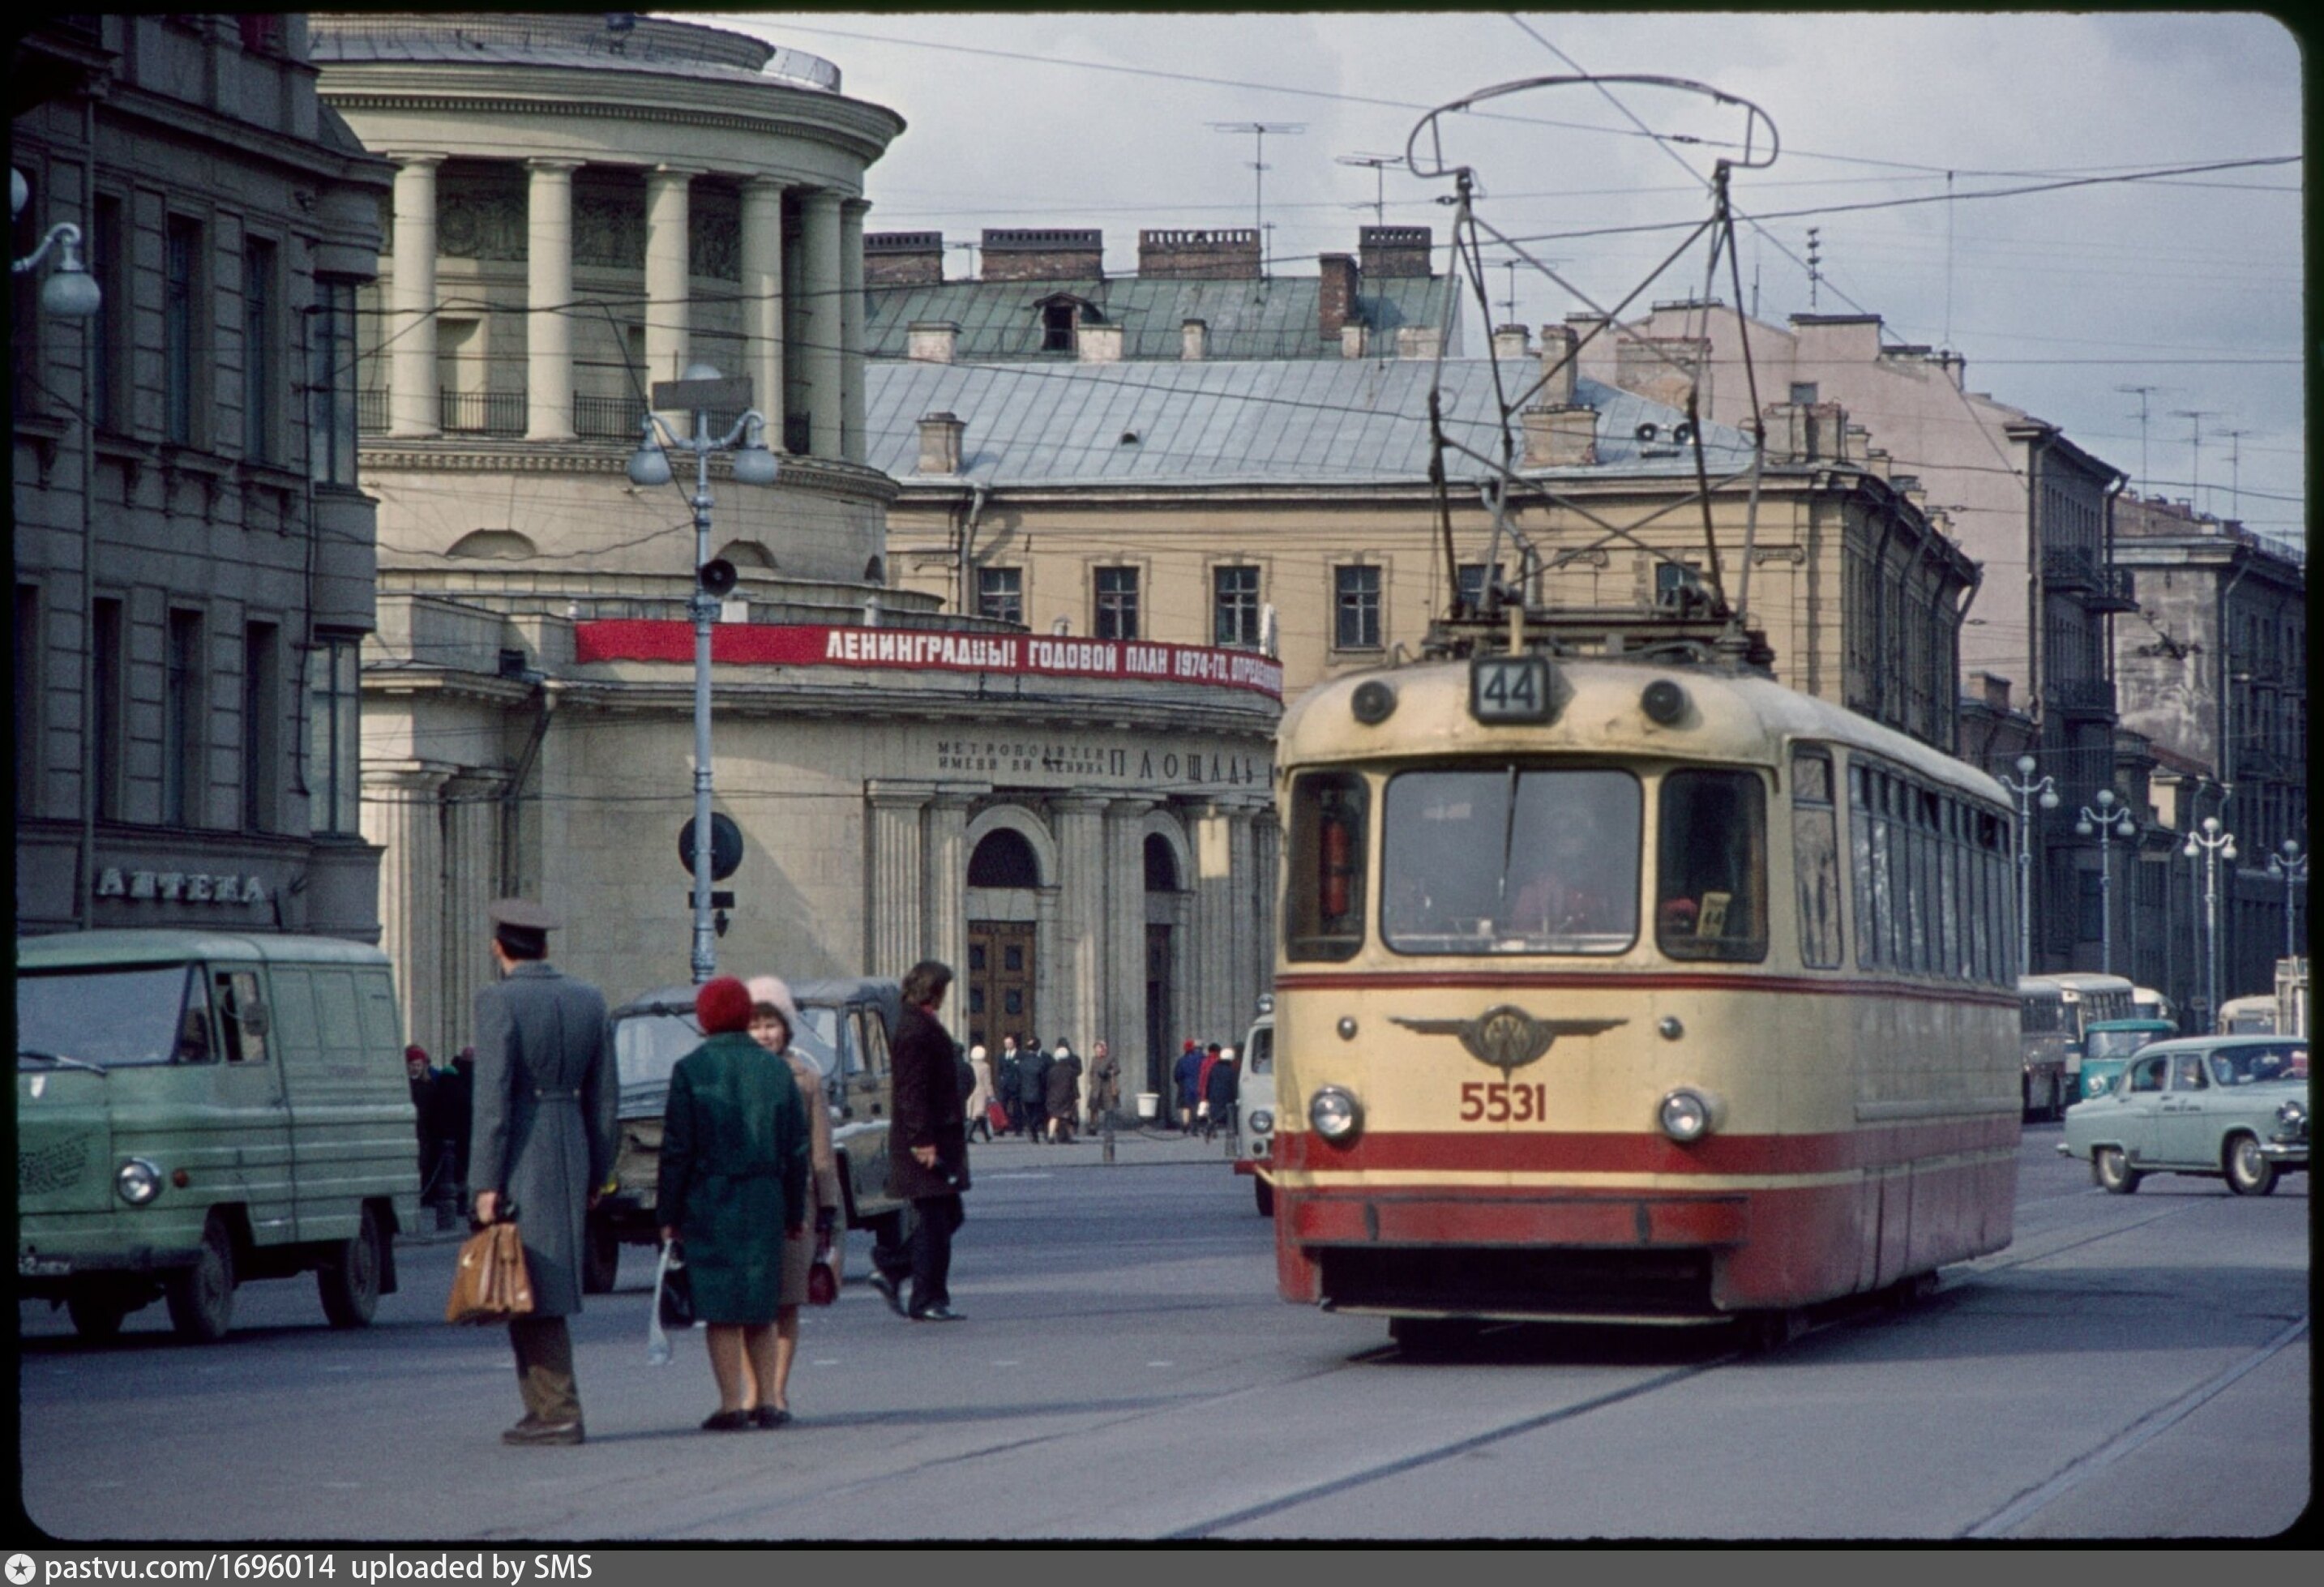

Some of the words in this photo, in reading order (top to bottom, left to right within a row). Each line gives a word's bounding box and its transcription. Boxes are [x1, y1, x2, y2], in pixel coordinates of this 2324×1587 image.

[826, 631, 1016, 667] ЛЕНИНГРАДЦЫ!
[1029, 641, 1116, 673] ГОДОВОЙ
[1126, 646, 1167, 674] ПЛАН
[1175, 649, 1228, 683] 1974-ГО,
[1483, 665, 1535, 709] 44
[938, 741, 1104, 760] МЕТРОПОЛИТЕН
[939, 756, 997, 771] ИМЕНИ
[1110, 749, 1252, 785] ПЛОЩАДЬ
[96, 868, 266, 902] АПТЕКА
[1460, 1082, 1546, 1123] 5531
